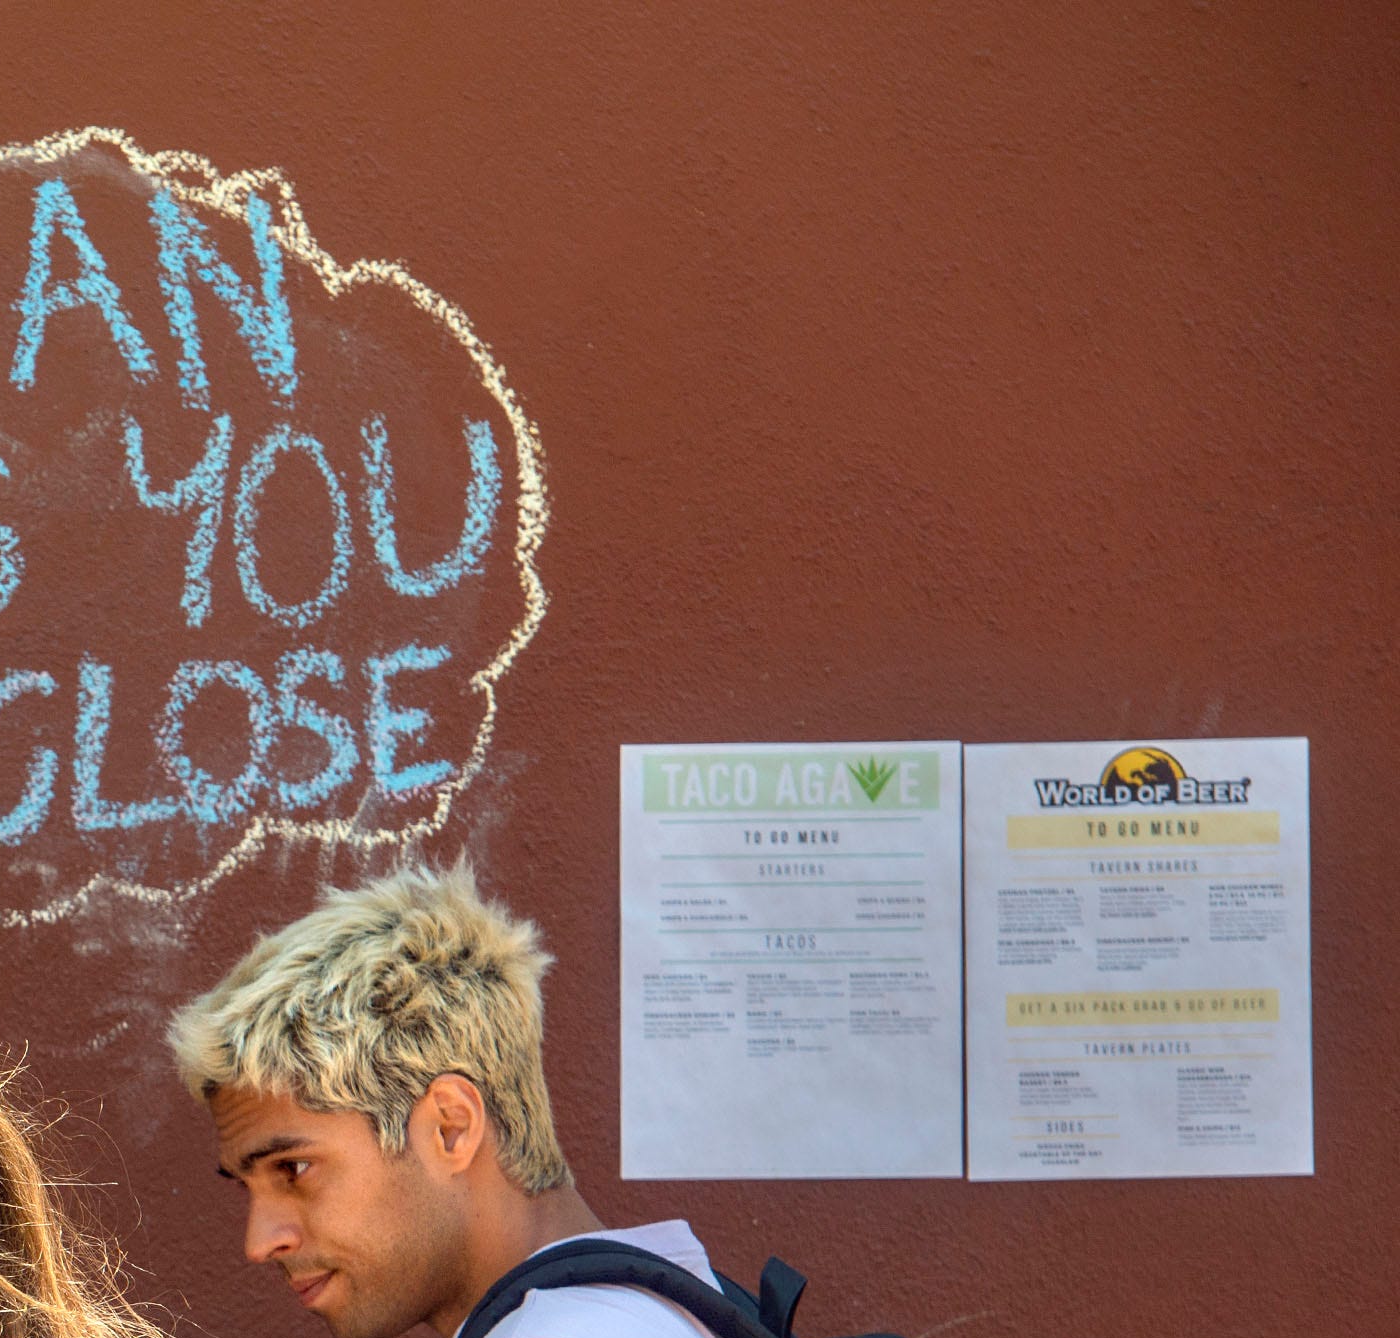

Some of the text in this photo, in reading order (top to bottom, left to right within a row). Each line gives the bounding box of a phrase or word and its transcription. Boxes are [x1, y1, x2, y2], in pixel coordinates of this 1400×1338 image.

[121, 410, 503, 628] YOU
[660, 761, 758, 807] TACO
[1035, 777, 1251, 807] WORLD OF BEER
[1086, 819, 1201, 838] TO GO MENU
[744, 829, 841, 845] TO GO MENU
[758, 862, 826, 877] STARTERS
[1089, 859, 1199, 875] TAVERN SHARES
[764, 933, 818, 950] TACOS
[1082, 1040, 1193, 1056] TAVERN PLATES
[1045, 1119, 1085, 1134] SIDES
